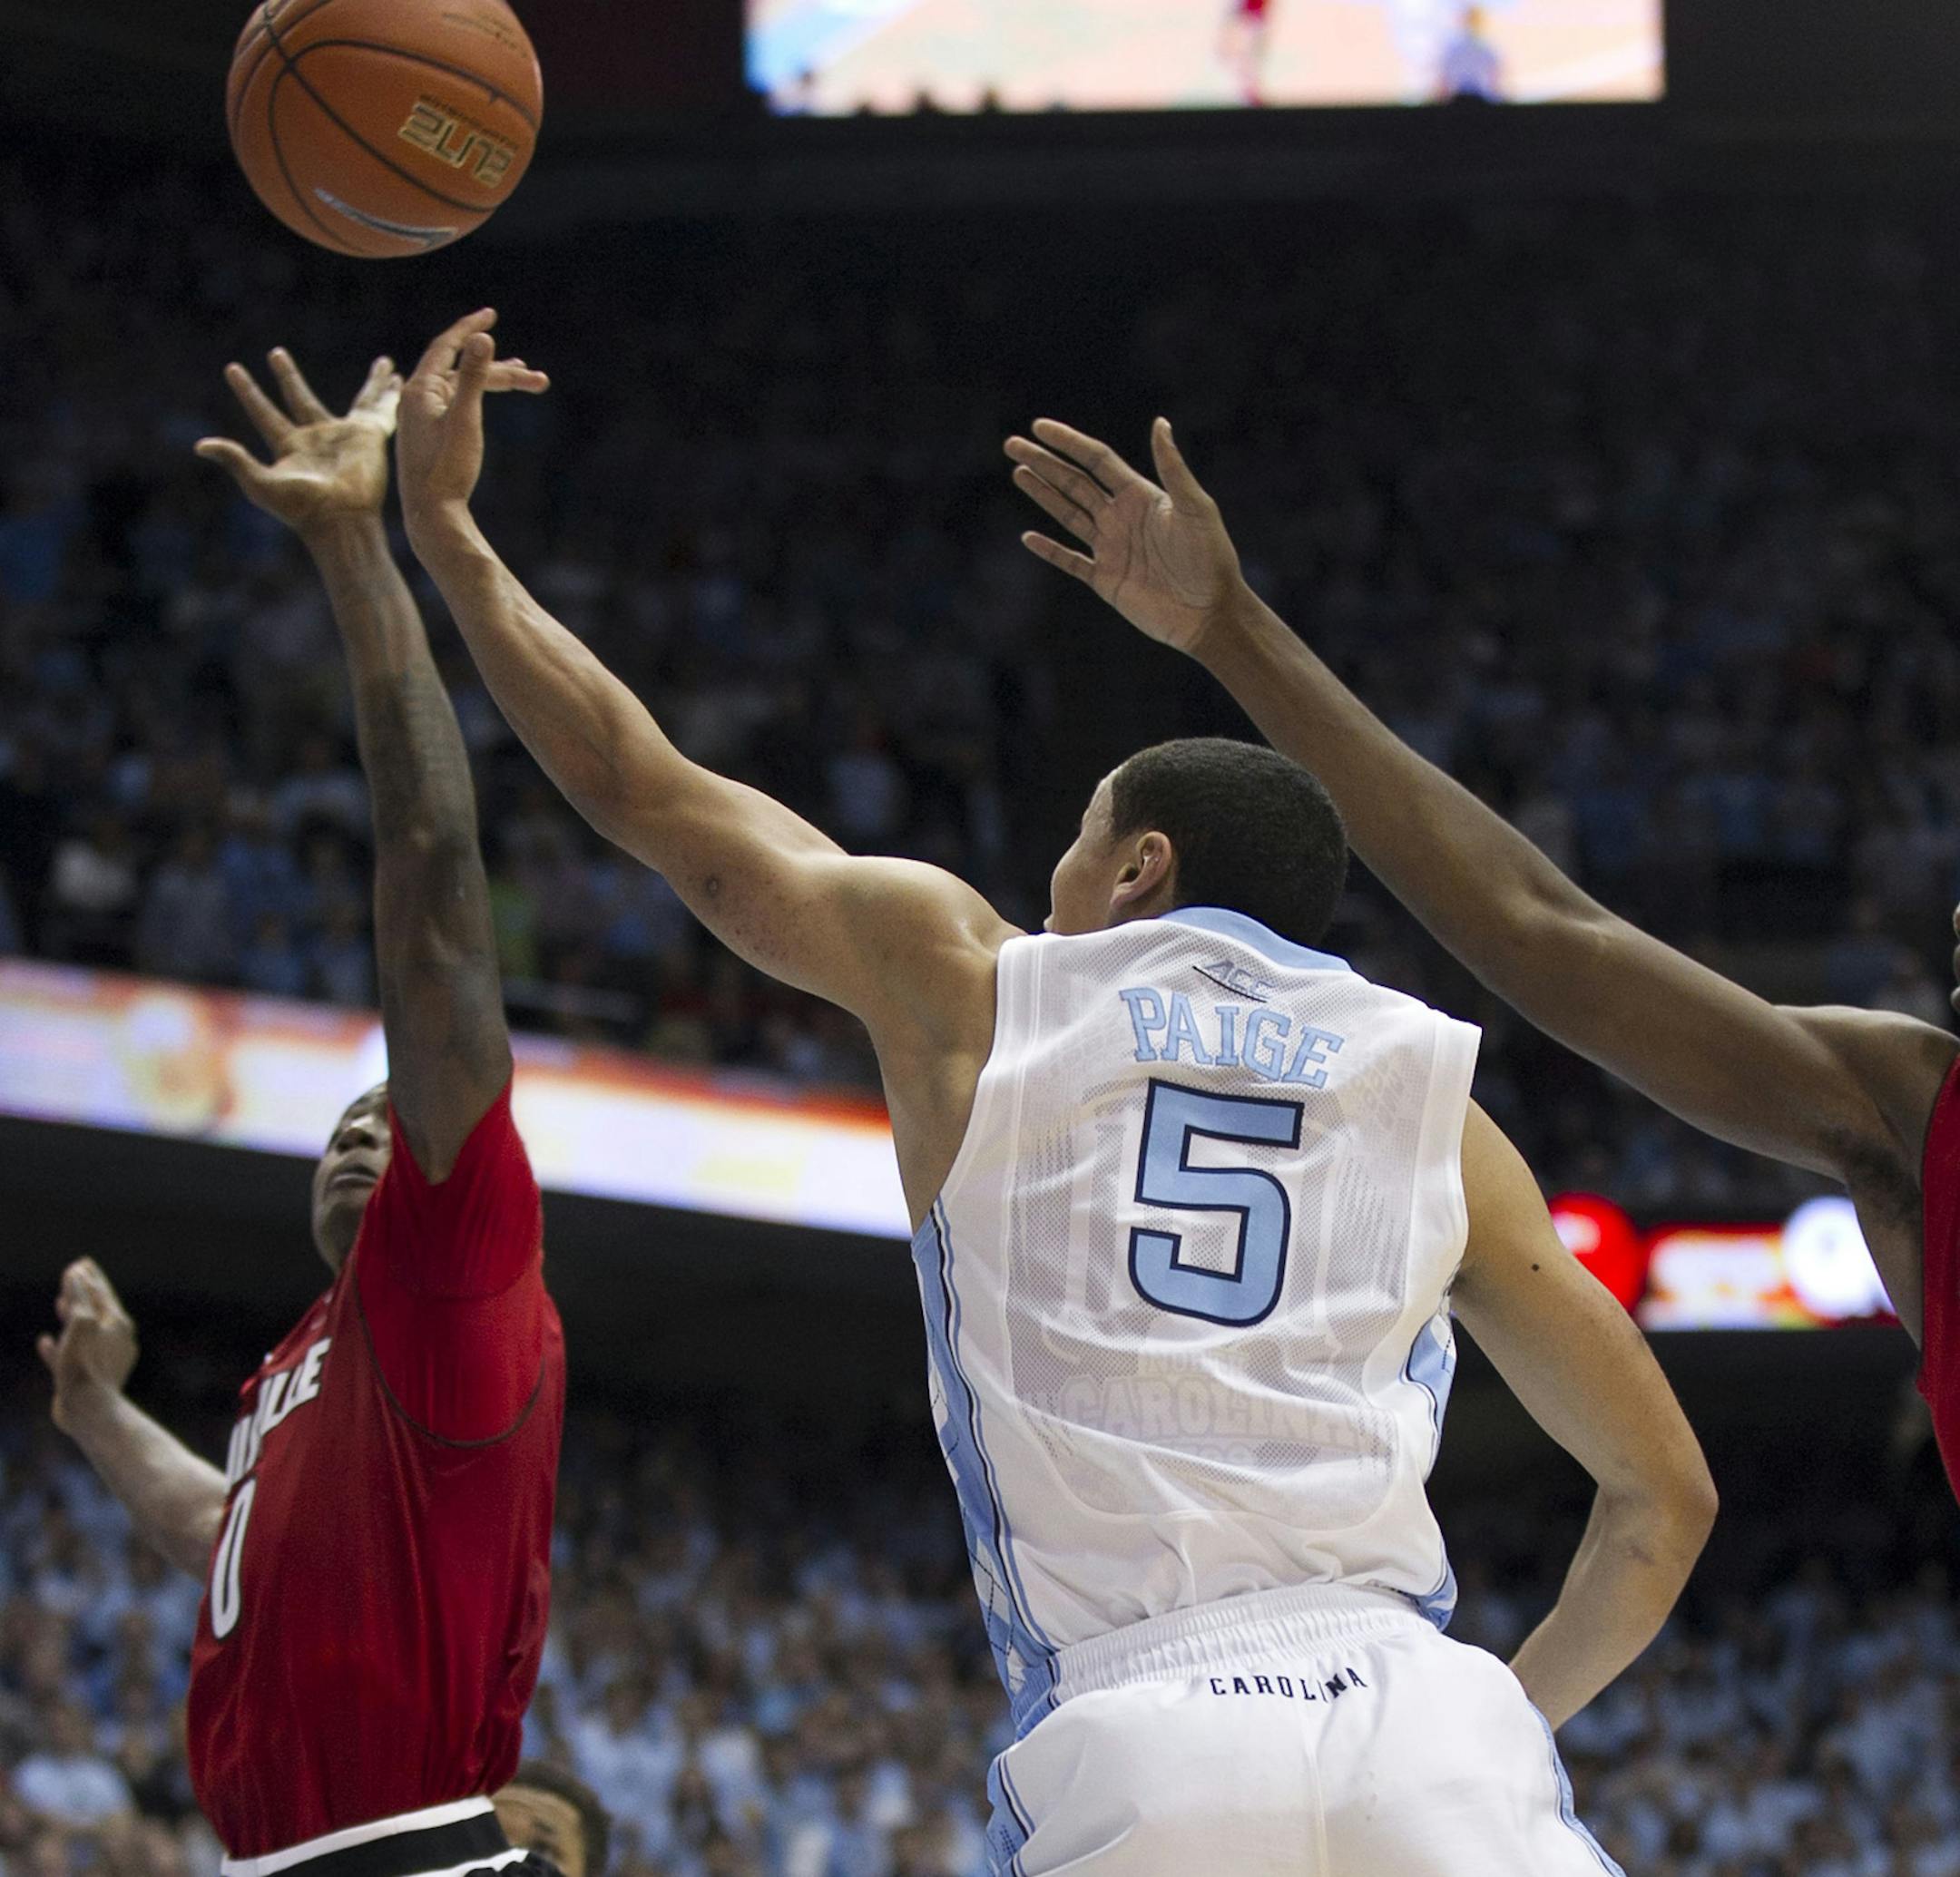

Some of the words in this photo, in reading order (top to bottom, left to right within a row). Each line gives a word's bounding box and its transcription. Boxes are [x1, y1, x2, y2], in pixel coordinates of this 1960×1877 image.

[1202, 960, 1278, 1000] ACC
[1119, 986, 1345, 1089] PAIGE
[1128, 1077, 1305, 1327] 5
[211, 1477, 257, 1640] 0
[1210, 1667, 1368, 1704] CAROLINA
